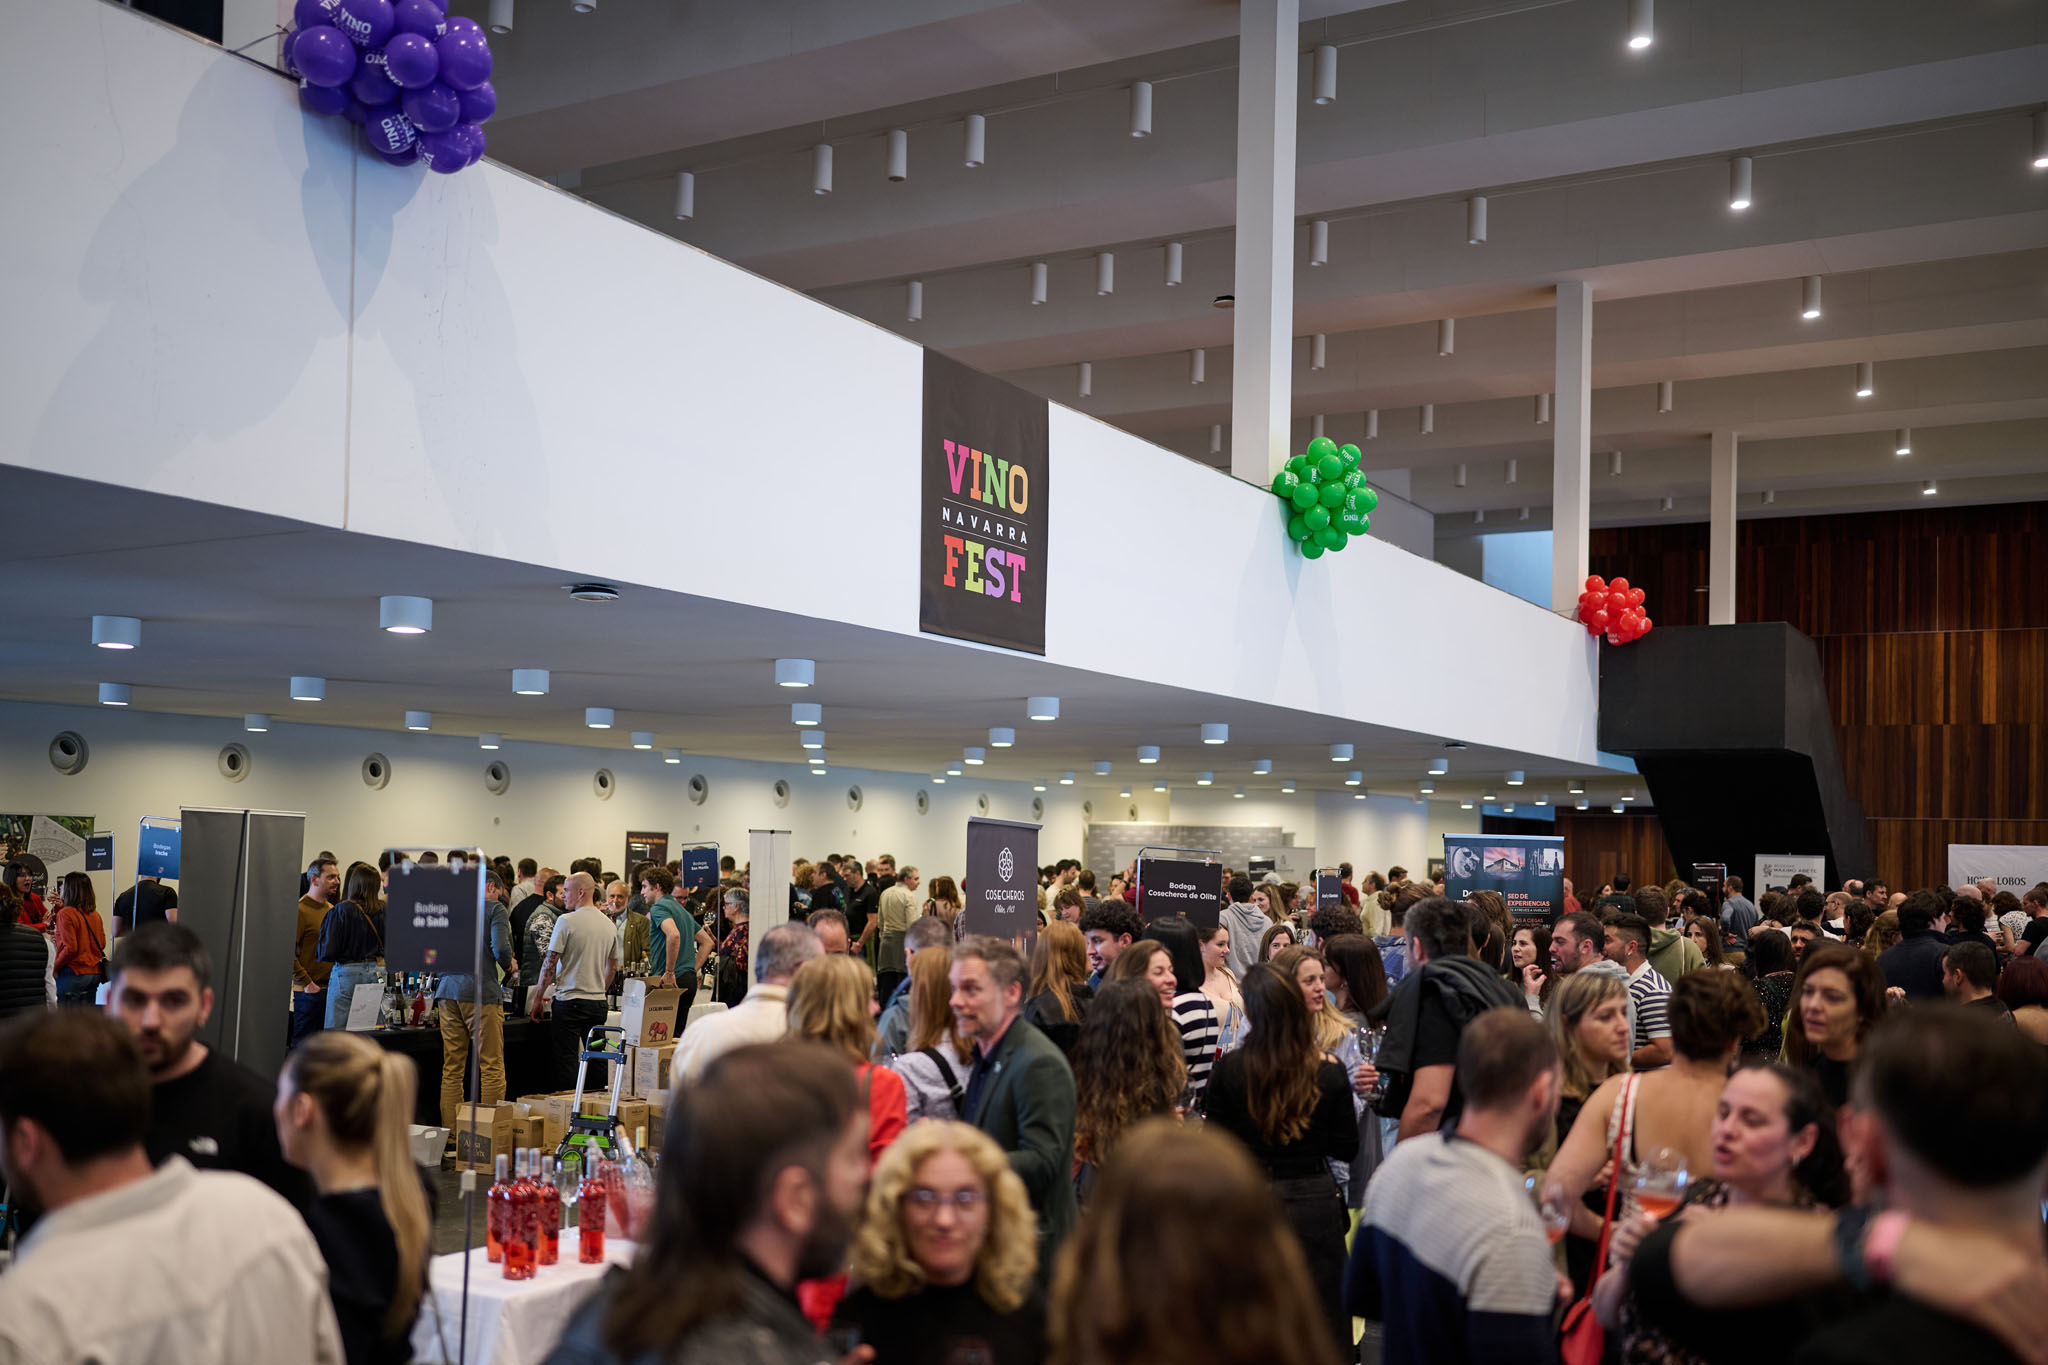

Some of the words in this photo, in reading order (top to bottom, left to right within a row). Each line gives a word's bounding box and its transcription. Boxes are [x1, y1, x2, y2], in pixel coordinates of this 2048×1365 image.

[341, 8, 372, 34] VINO
[381, 118, 401, 150] VINO
[943, 438, 1029, 514] VINO
[942, 506, 1028, 545] NAVARRA
[943, 534, 1026, 604] FEST
[1169, 882, 1197, 891] Bodega
[1997, 876, 2026, 885] LOBOS
[985, 889, 1025, 901] COSECHEROS
[1148, 889, 1188, 899] Cosecheros
[1200, 892, 1217, 900] Olite
[414, 902, 449, 914] Bodega
[413, 916, 425, 927] de
